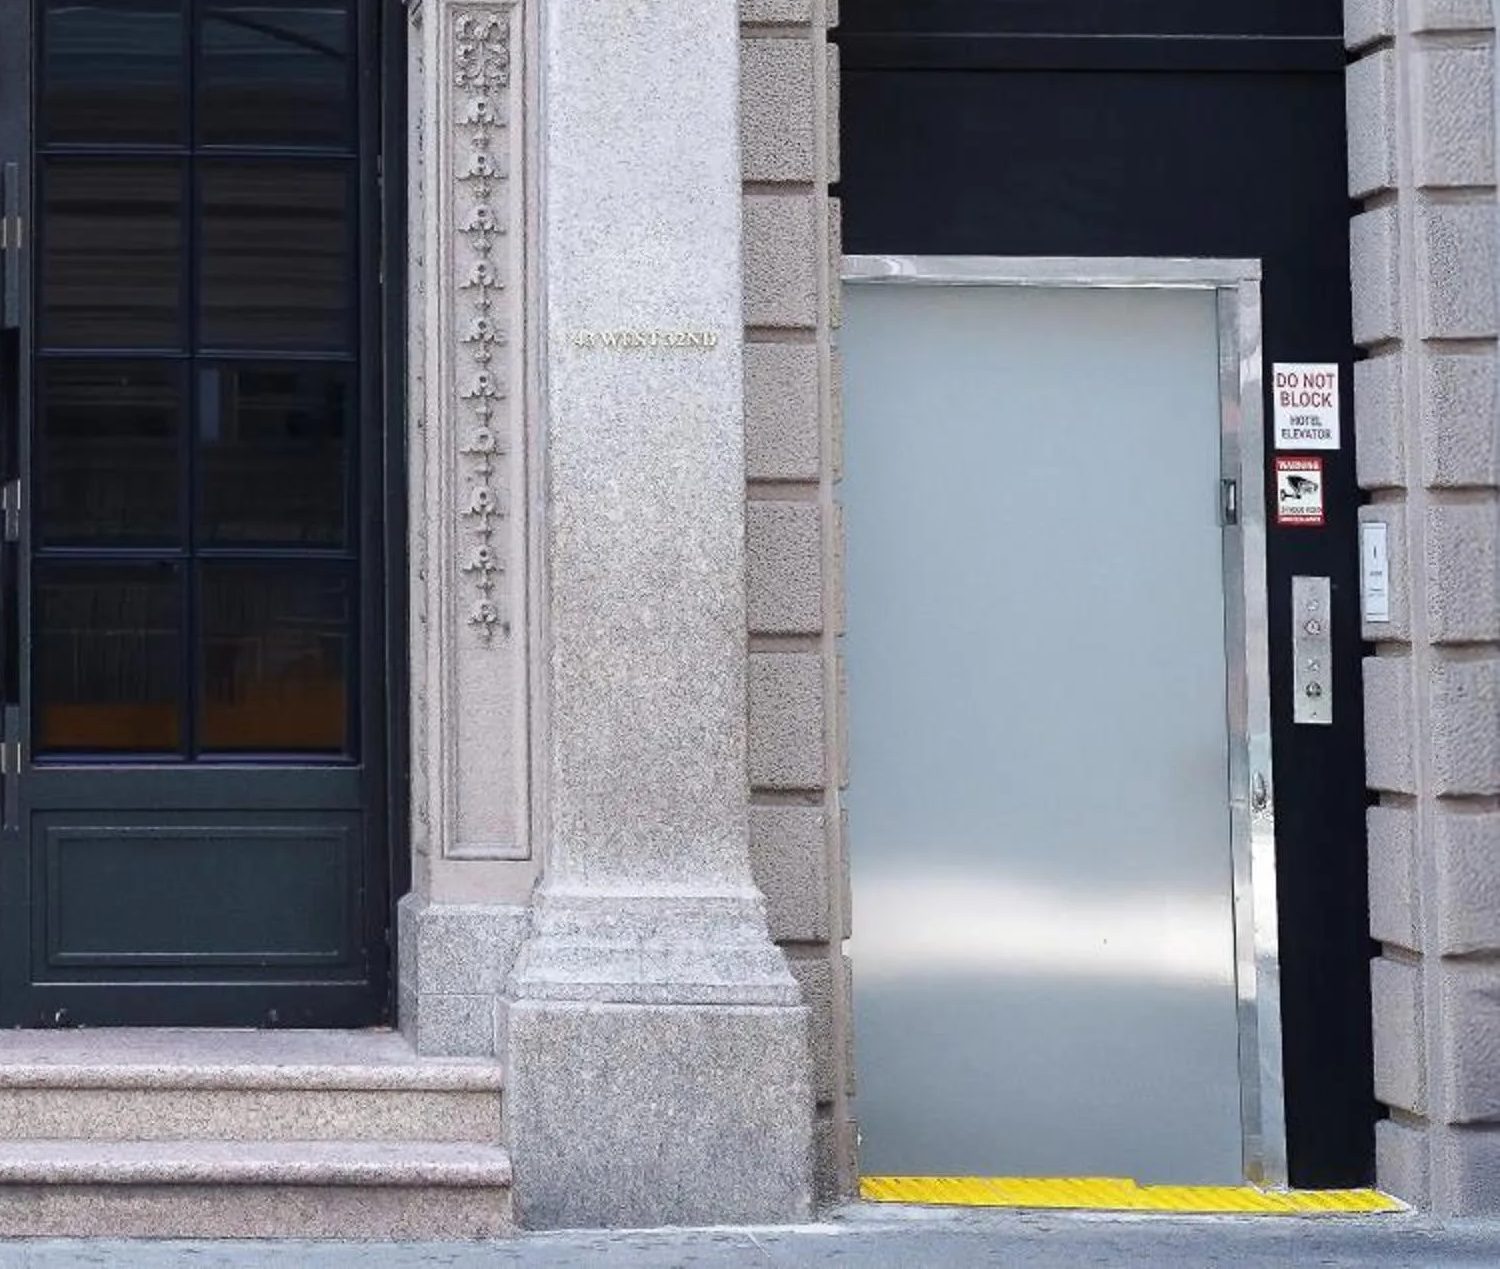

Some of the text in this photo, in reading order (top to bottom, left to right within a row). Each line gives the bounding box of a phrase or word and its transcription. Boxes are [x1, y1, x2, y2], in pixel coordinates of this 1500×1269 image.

[600, 330, 660, 347] WEST
[663, 331, 719, 348] 32ND
[1276, 372, 1335, 389] DO NOT
[1280, 391, 1333, 408] BLOCK
[1290, 415, 1323, 427] HOTEL
[1281, 428, 1333, 440] ELEVATOR
